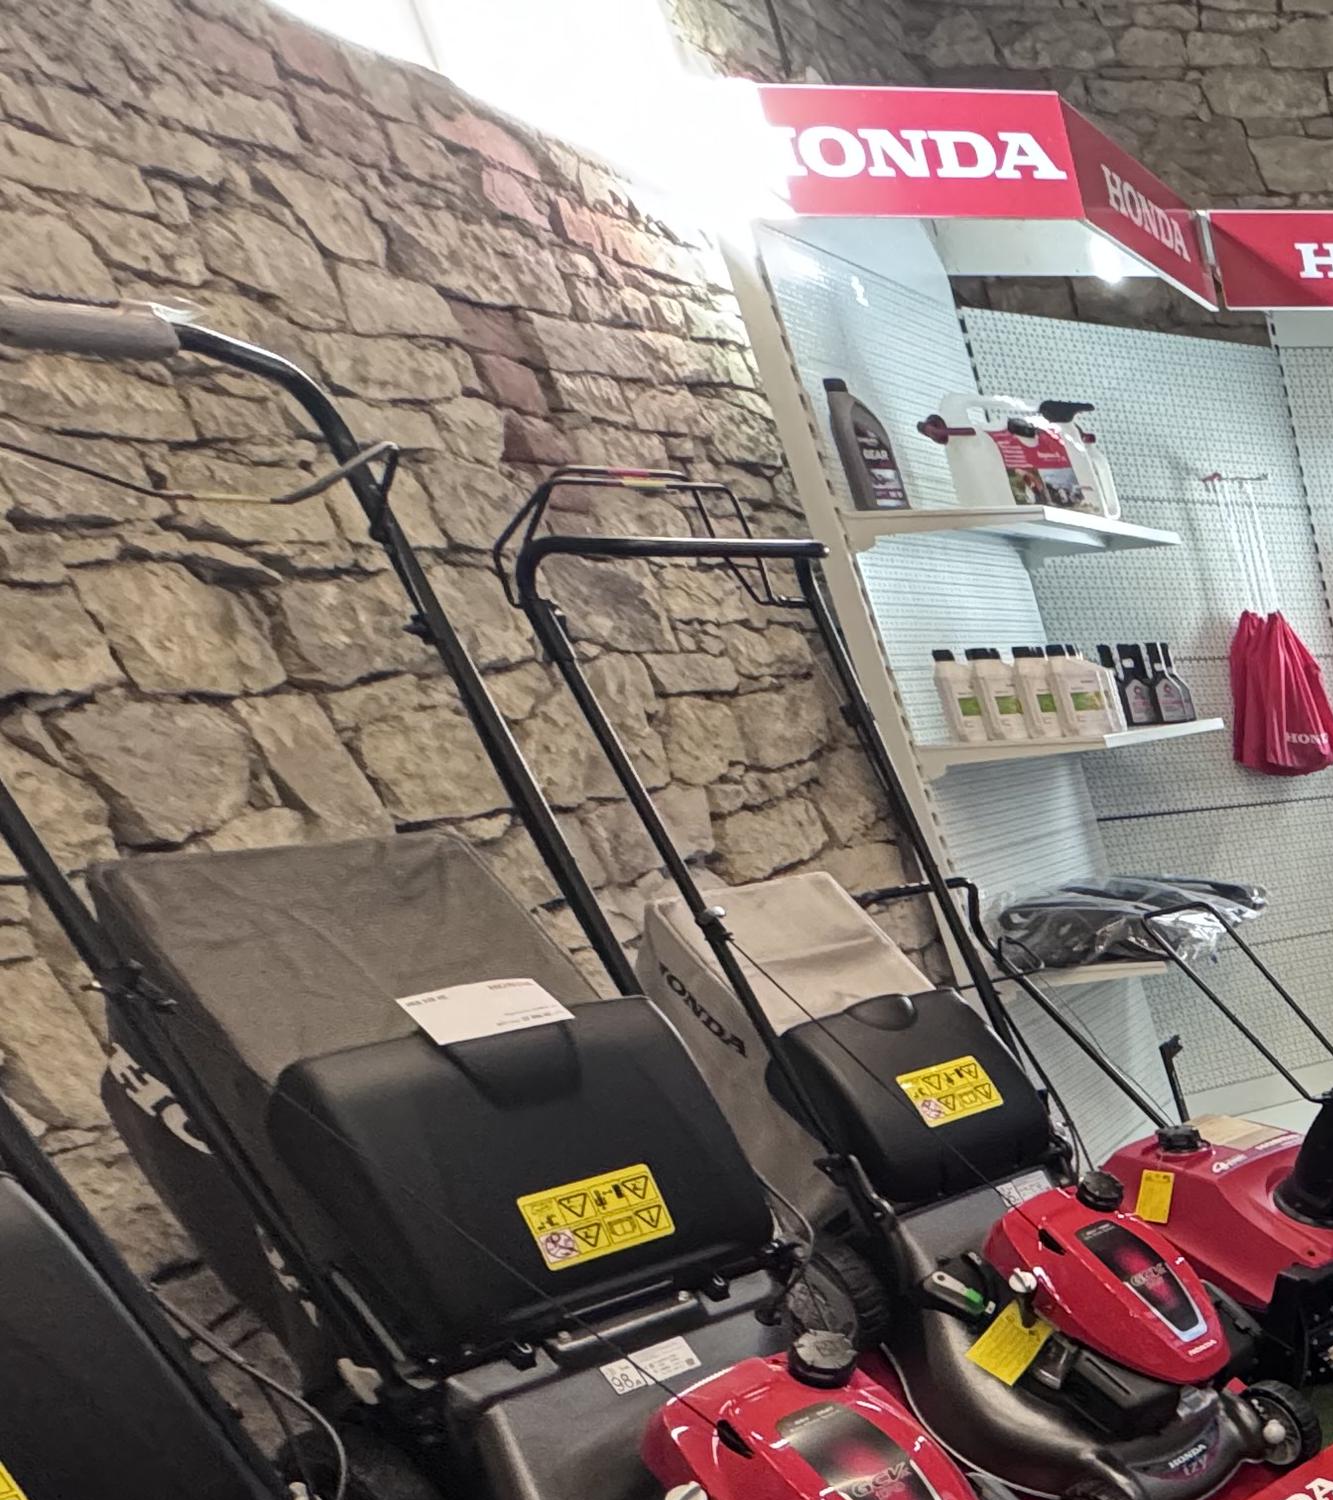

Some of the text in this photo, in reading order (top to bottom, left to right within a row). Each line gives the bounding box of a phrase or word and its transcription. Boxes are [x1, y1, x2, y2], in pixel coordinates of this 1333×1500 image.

[1101, 164, 1193, 263] HONDA
[611, 1372, 635, 1392] 98
[1168, 1443, 1208, 1469] HONDA
